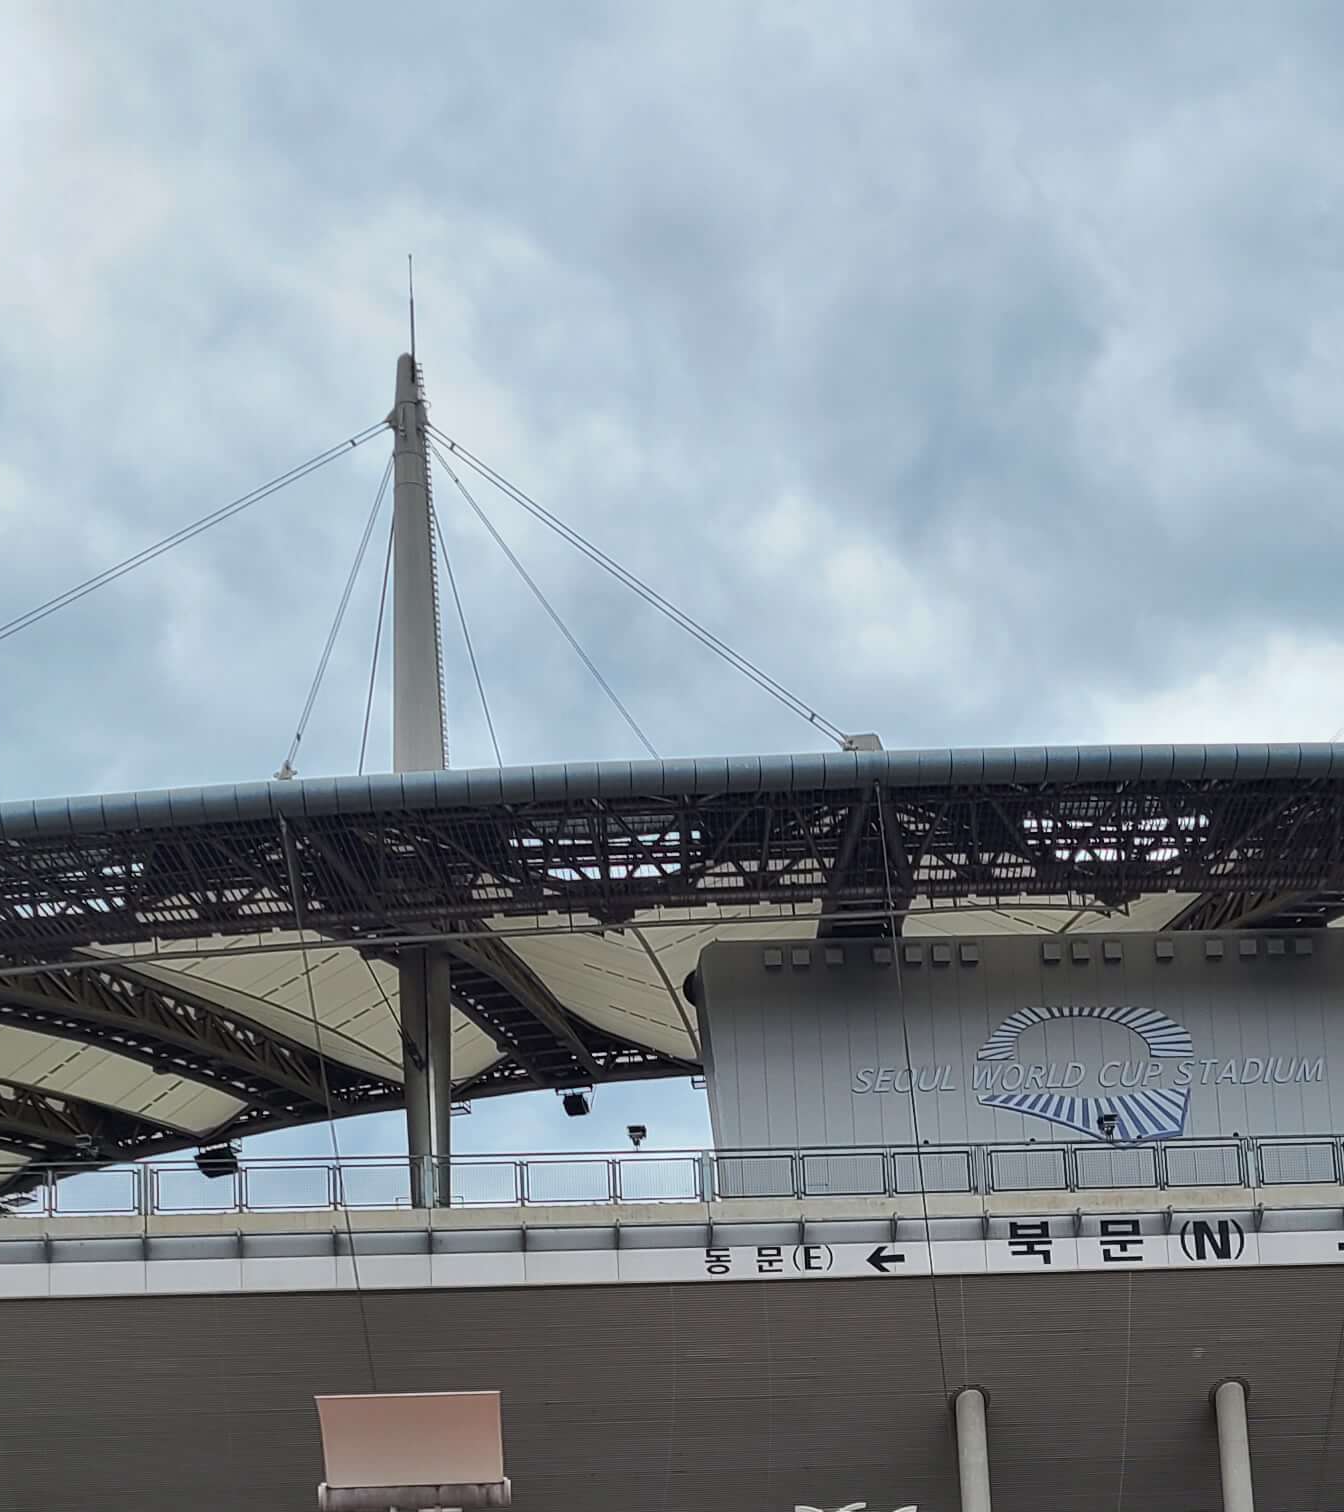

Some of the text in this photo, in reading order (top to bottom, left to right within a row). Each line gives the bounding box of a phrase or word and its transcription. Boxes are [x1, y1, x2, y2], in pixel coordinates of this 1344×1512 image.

[852, 1056, 1325, 1094] SEOUL WORLD CUP STADIUM
